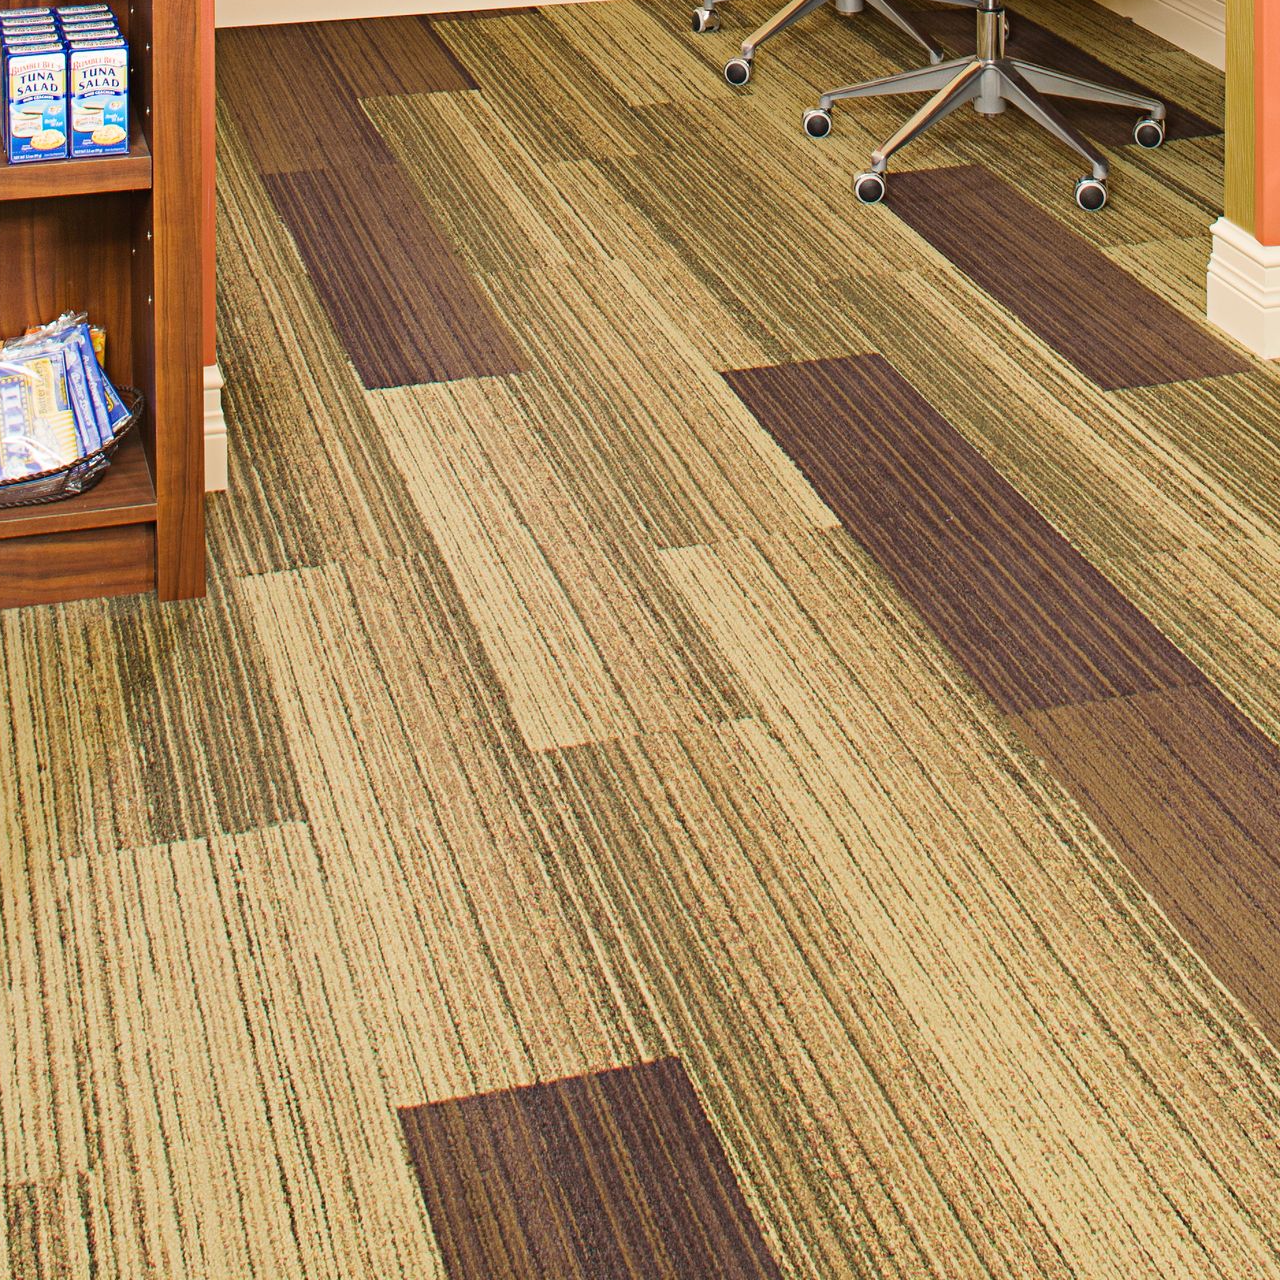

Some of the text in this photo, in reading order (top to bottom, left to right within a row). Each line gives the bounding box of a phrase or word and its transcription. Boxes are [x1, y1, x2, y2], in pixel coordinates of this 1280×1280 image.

[11, 62, 54, 76] BUMBLE BEE
[72, 56, 117, 71] BUMBLE BEE
[20, 72, 55, 85] TUNA
[82, 67, 116, 79] TUNA
[17, 83, 58, 97] SALAD
[78, 78, 120, 90] SALAD
